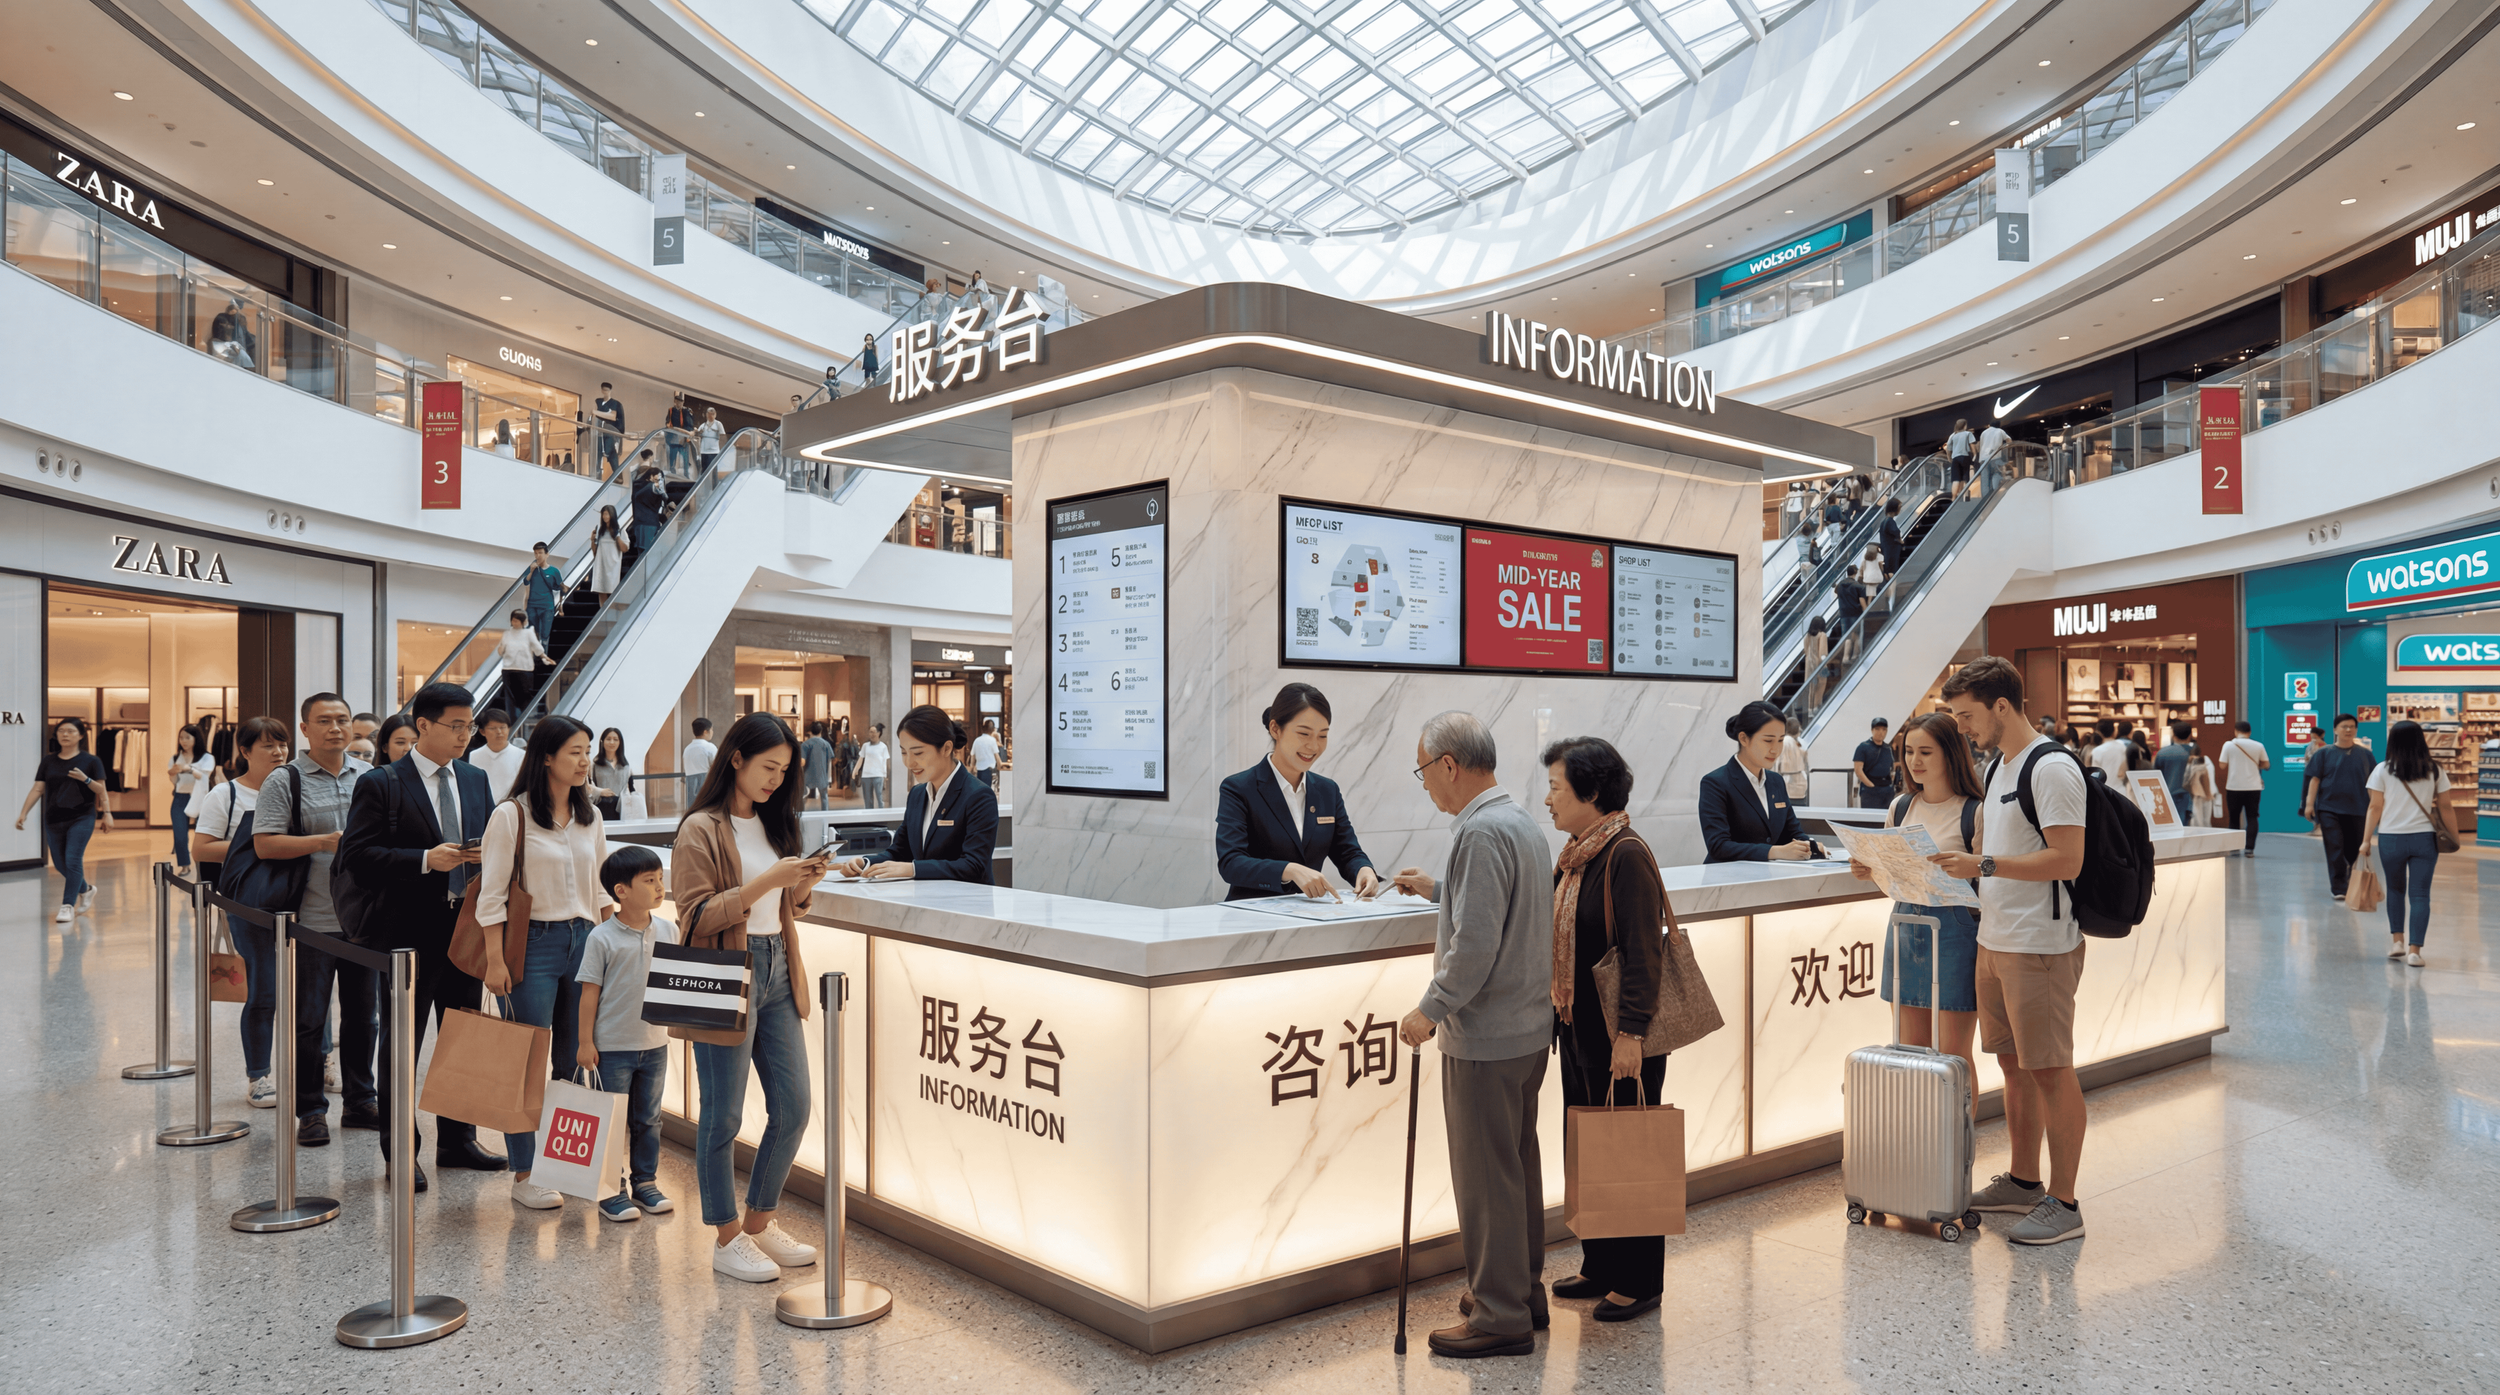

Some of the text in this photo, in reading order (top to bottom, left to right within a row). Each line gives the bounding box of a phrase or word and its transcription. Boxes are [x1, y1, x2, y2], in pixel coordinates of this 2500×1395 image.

[57, 152, 164, 230] ZARA
[662, 228, 674, 248] 5
[2007, 224, 2020, 244] 5
[2415, 211, 2471, 266] MUJI
[889, 286, 1045, 403] 服务台
[1486, 310, 1716, 414] INFORMATION
[434, 460, 449, 485] 3
[2213, 466, 2230, 490] 2
[112, 535, 233, 586] ZARA
[1059, 555, 1065, 574] 1
[1111, 547, 1121, 567] 5
[1311, 552, 1319, 564] 8
[1498, 563, 1581, 591] MID-YEAR
[2367, 550, 2489, 594] watsons
[1058, 594, 1067, 614] 2
[1497, 588, 1582, 632] SALE
[2053, 602, 2107, 637] MUJI
[1058, 633, 1067, 653] 3
[1058, 672, 1068, 692] 4
[1111, 670, 1121, 691] 6
[1058, 711, 1068, 731] 5
[668, 977, 723, 991] SEPHORA
[1789, 941, 1876, 1008] 欢迎
[919, 995, 1066, 1097] 服务台
[1261, 1013, 1398, 1107] 咨询
[919, 1073, 1065, 1144] INFORMATION
[557, 1115, 592, 1139] UNI
[552, 1136, 589, 1158] QLO
